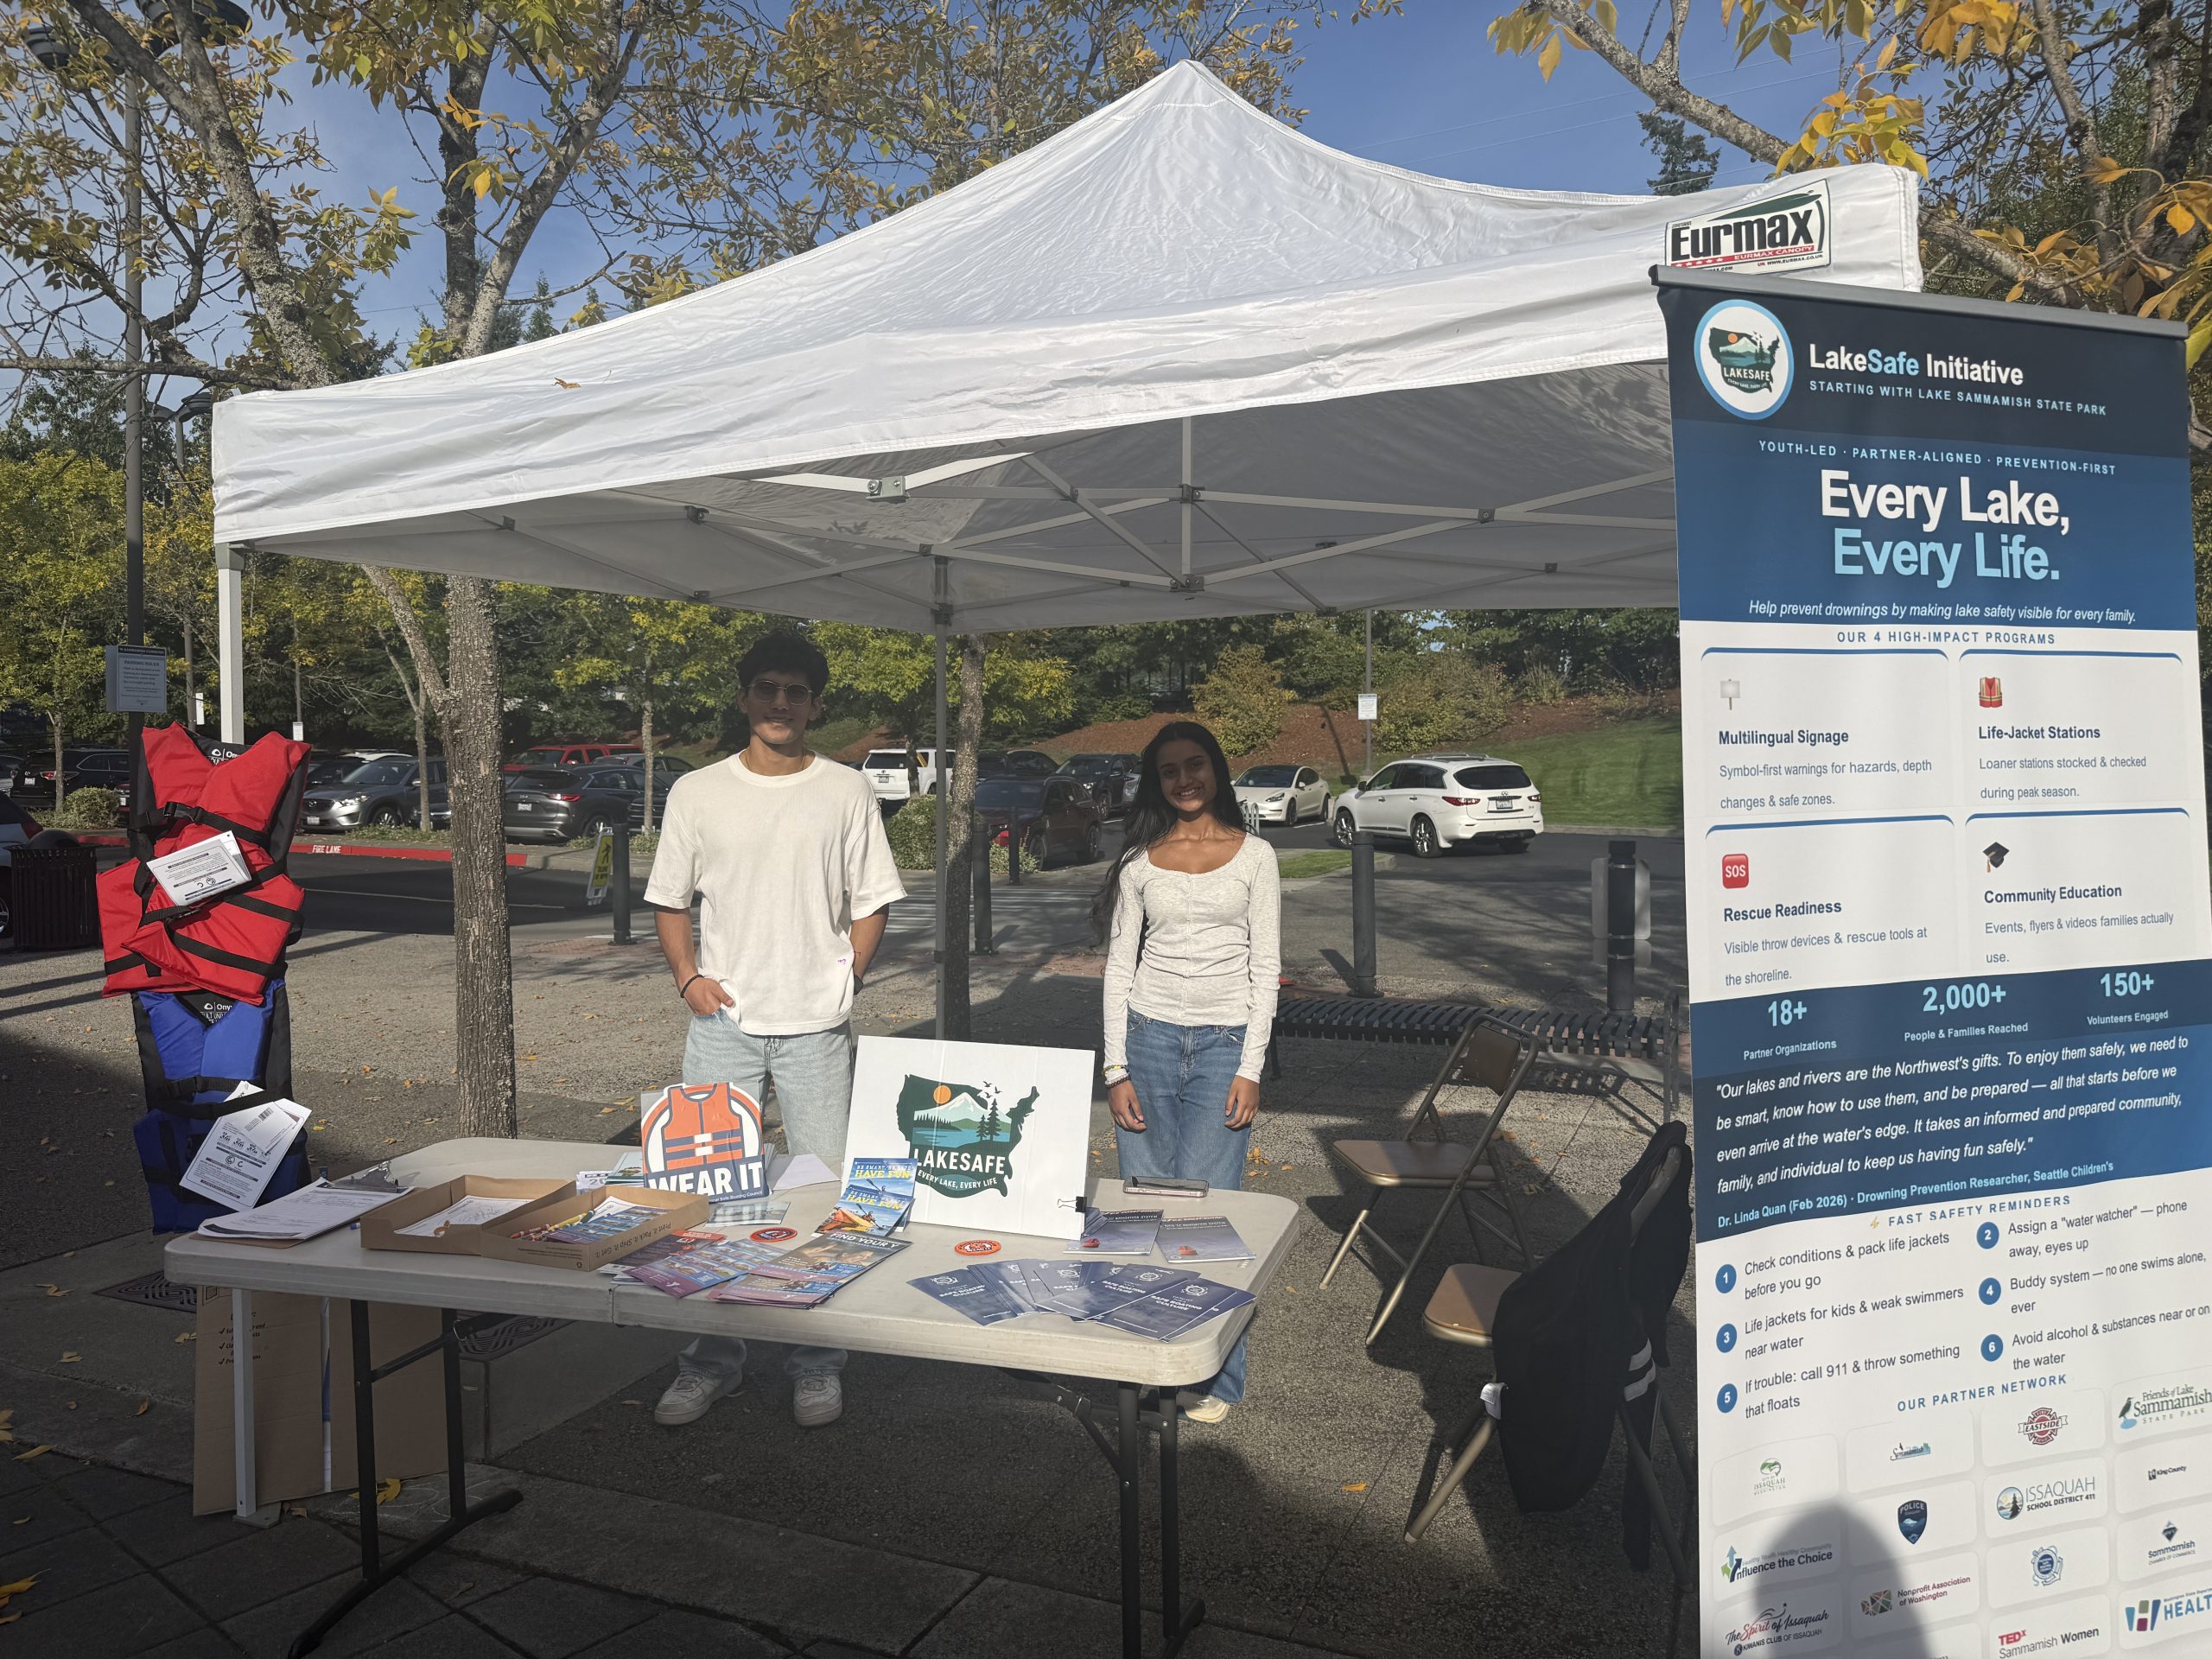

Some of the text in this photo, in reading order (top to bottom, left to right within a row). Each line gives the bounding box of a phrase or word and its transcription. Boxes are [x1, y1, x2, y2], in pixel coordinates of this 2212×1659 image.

[1672, 210, 1814, 261] Eurmax
[1734, 245, 1812, 260] EURMAX CANOPY
[1724, 367, 1770, 381] LAKESAFE
[1809, 344, 2024, 385] LakeSafe Initiative
[1809, 380, 2106, 415] STARTING WITH LAKE SAMMAMISH STATE PARK
[1759, 441, 2115, 474] YOUTH-LED PARTNER-ALIGNED PREVENTION-FIRST
[1821, 469, 2069, 535] Every Lake,
[1834, 528, 2060, 588] Every Life.
[1750, 601, 2135, 623] Help prevent drownings by making lake safety visible for every family.
[1837, 632, 2055, 645] OUR 4 HIGH-IMPACT PROGRAMS
[1719, 729, 1848, 747] Multilingual Signage
[1979, 726, 2101, 739] Life-Jacket Stations
[1725, 865, 1745, 878] SOS
[1985, 885, 2122, 904] Community Education
[1724, 901, 1842, 922] Rescue Readiness
[2100, 971, 2154, 997] 150+
[1923, 982, 2006, 1015] 2,000+
[1768, 999, 1808, 1027] 18+
[2088, 1010, 2168, 1025] Volunteers Engaged
[1904, 1023, 2028, 1042] People & Families Reached
[1744, 1039, 1837, 1060] Partner Organizations
[1716, 1037, 2188, 1098] "Our lakes and rivers are the Northwest's gifts. To enjoy them safely, we need to
[913, 1148, 1005, 1174] LAKESAFE
[648, 1161, 762, 1196] WEAR IT
[855, 1170, 885, 1179] HAVE
[918, 1170, 997, 1189] EVERY LAKE, EVERY LIFE
[847, 1194, 876, 1205] HAVE
[880, 1200, 901, 1209] FUN
[1889, 1196, 2070, 1226] FAST SAFETY REMINDERS
[639, 1231, 651, 1241] Pack
[659, 1222, 671, 1233] Print
[620, 1239, 632, 1248] Ship
[830, 1232, 855, 1241] FIND
[858, 1237, 890, 1247] YOUR
[1723, 1232, 1949, 1283] 1 Check conditions & pack life jackets
[1897, 1375, 2066, 1412] OUR PARTNER NETWORK
[2143, 1388, 2169, 1401] Friends
[2177, 1384, 2194, 1395] Lake
[2134, 1389, 2212, 1417] Sammamish
[2143, 1408, 2205, 1423] STATE PARK
[2025, 1421, 2059, 1432] EASTSIDE
[2026, 1477, 2094, 1502] ISSAQUAH
[1900, 1503, 1925, 1514] POLICE
[2027, 1502, 2052, 1511] SCHOOL
[2054, 1495, 2082, 1505] DISTRICT
[1777, 1557, 1795, 1567] the
[1798, 1552, 1832, 1565] Choice
[2148, 1541, 2195, 1558] Sammamish
[1898, 1577, 1970, 1597] Nonprofit Association
[1908, 1591, 1948, 1604] Washington
[2164, 1594, 2212, 1620] HEALT
[1726, 1609, 1829, 1645] The Spirit of Issaquah
[1744, 1639, 1764, 1650] KIWANIS
[1766, 1636, 1782, 1644] CLUB
[1793, 1630, 1821, 1638] ISSAQUAH
[1999, 1628, 2099, 1659] Sammamish Women
